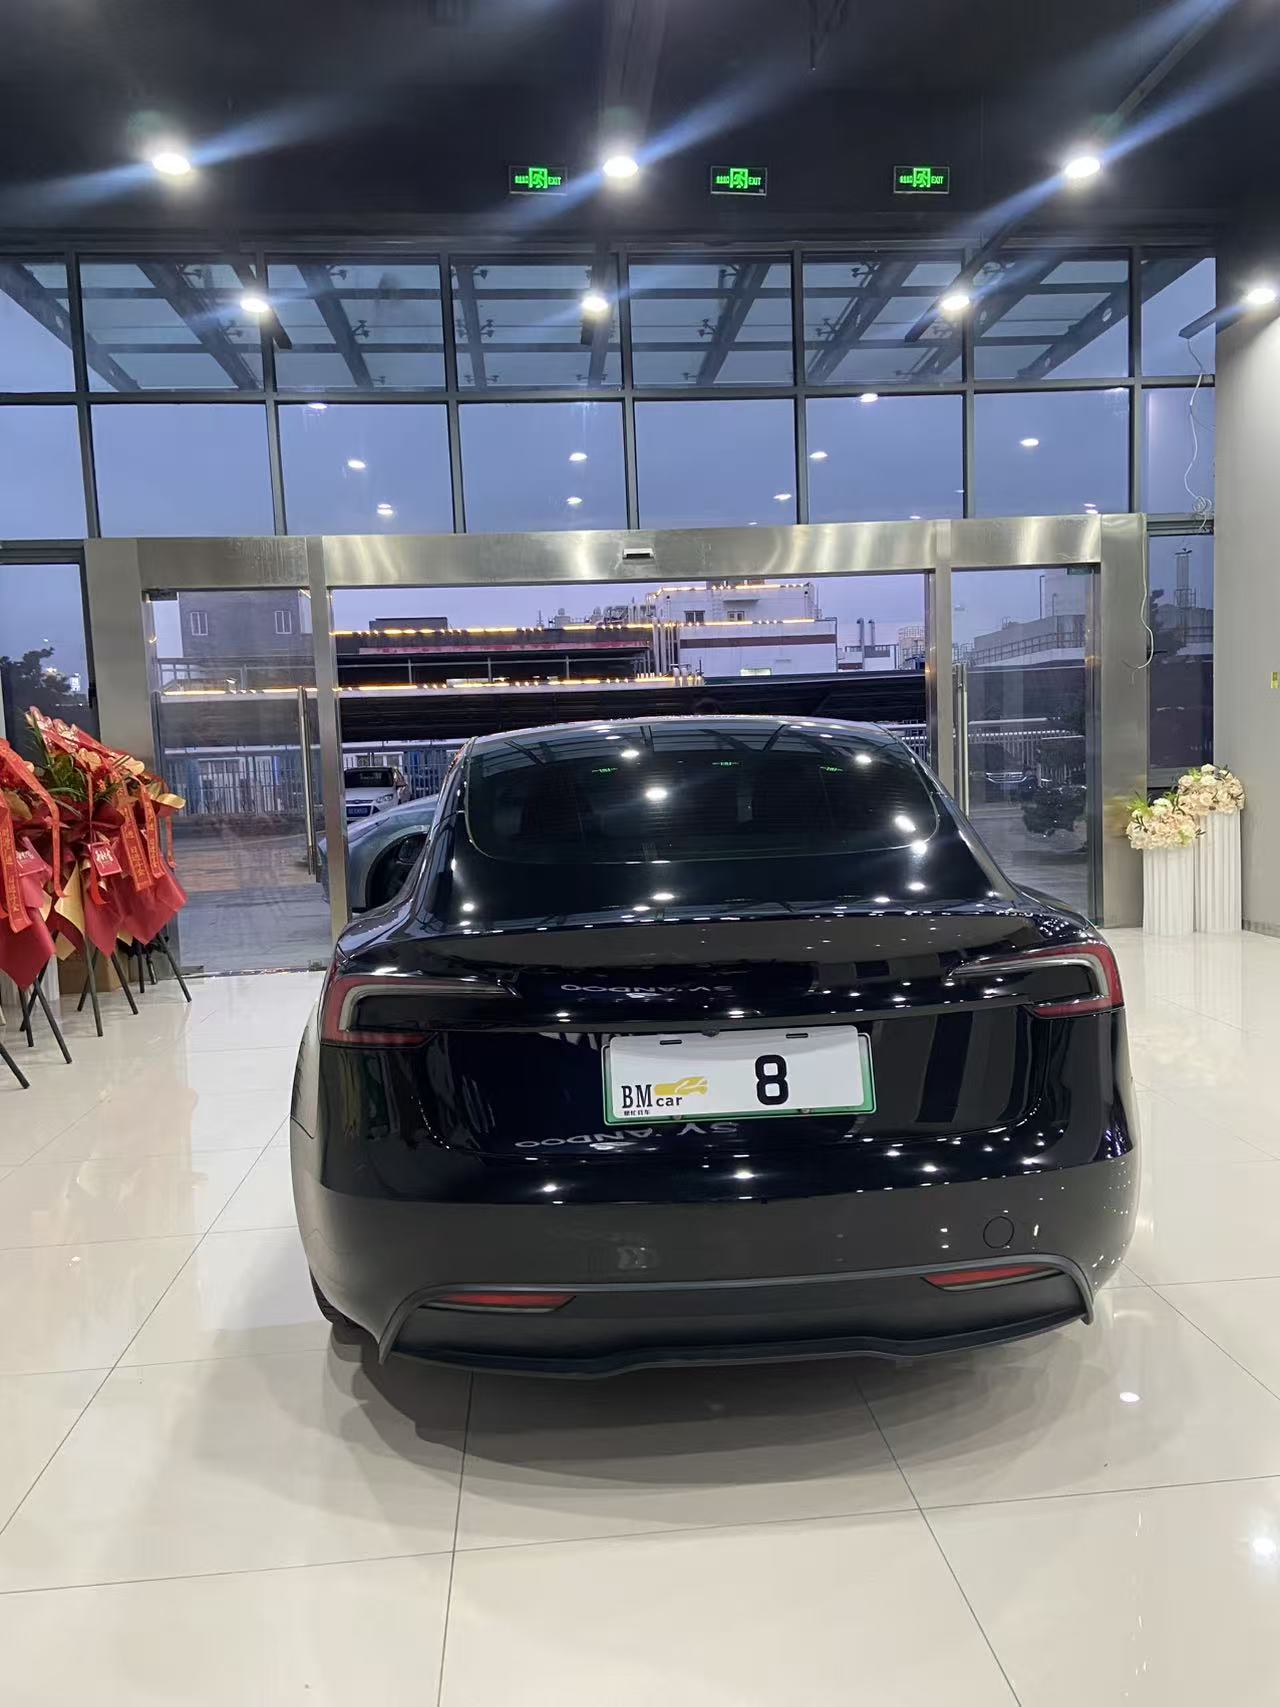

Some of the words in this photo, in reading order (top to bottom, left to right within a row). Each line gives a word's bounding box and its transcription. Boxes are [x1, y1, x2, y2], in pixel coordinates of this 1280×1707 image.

[931, 175, 943, 184] EXIT
[755, 1054, 789, 1106] 8
[621, 1084, 653, 1109] BM
[655, 1095, 682, 1107] car
